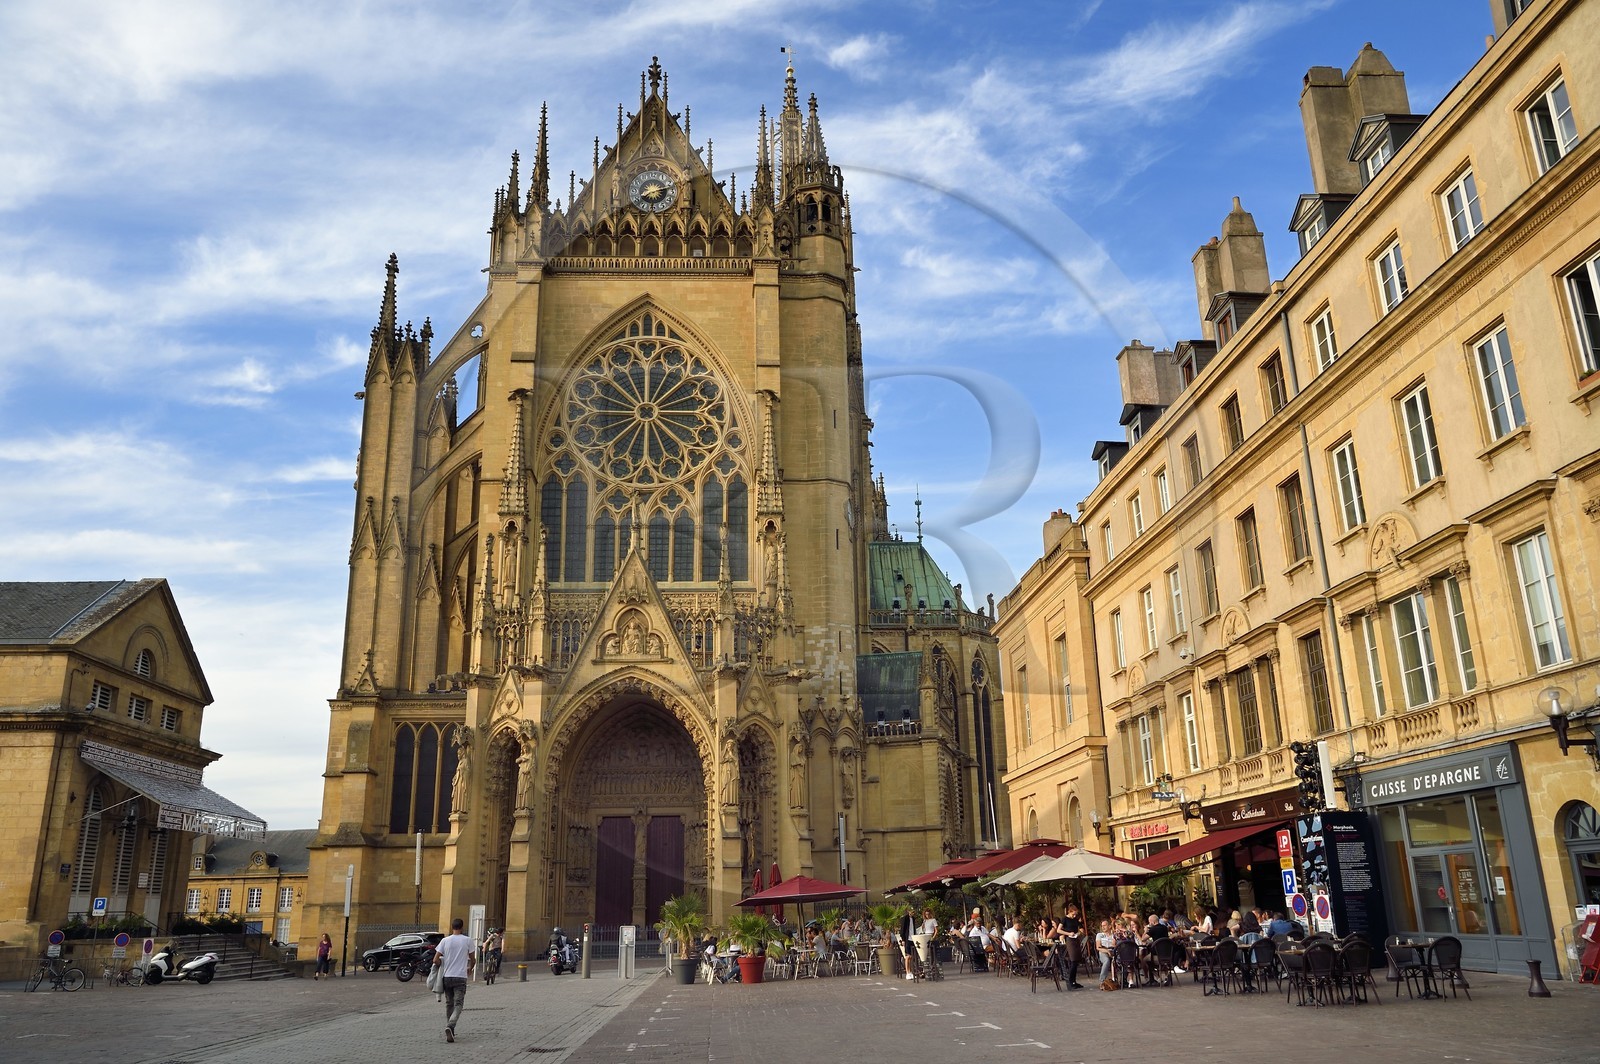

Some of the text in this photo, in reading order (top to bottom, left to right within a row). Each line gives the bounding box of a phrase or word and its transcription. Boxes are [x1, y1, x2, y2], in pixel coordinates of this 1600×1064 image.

[1371, 765, 1481, 798] CAISSE D'EPARGNE
[1281, 835, 1288, 848] P
[1285, 874, 1292, 891] P
[96, 900, 103, 908] P
